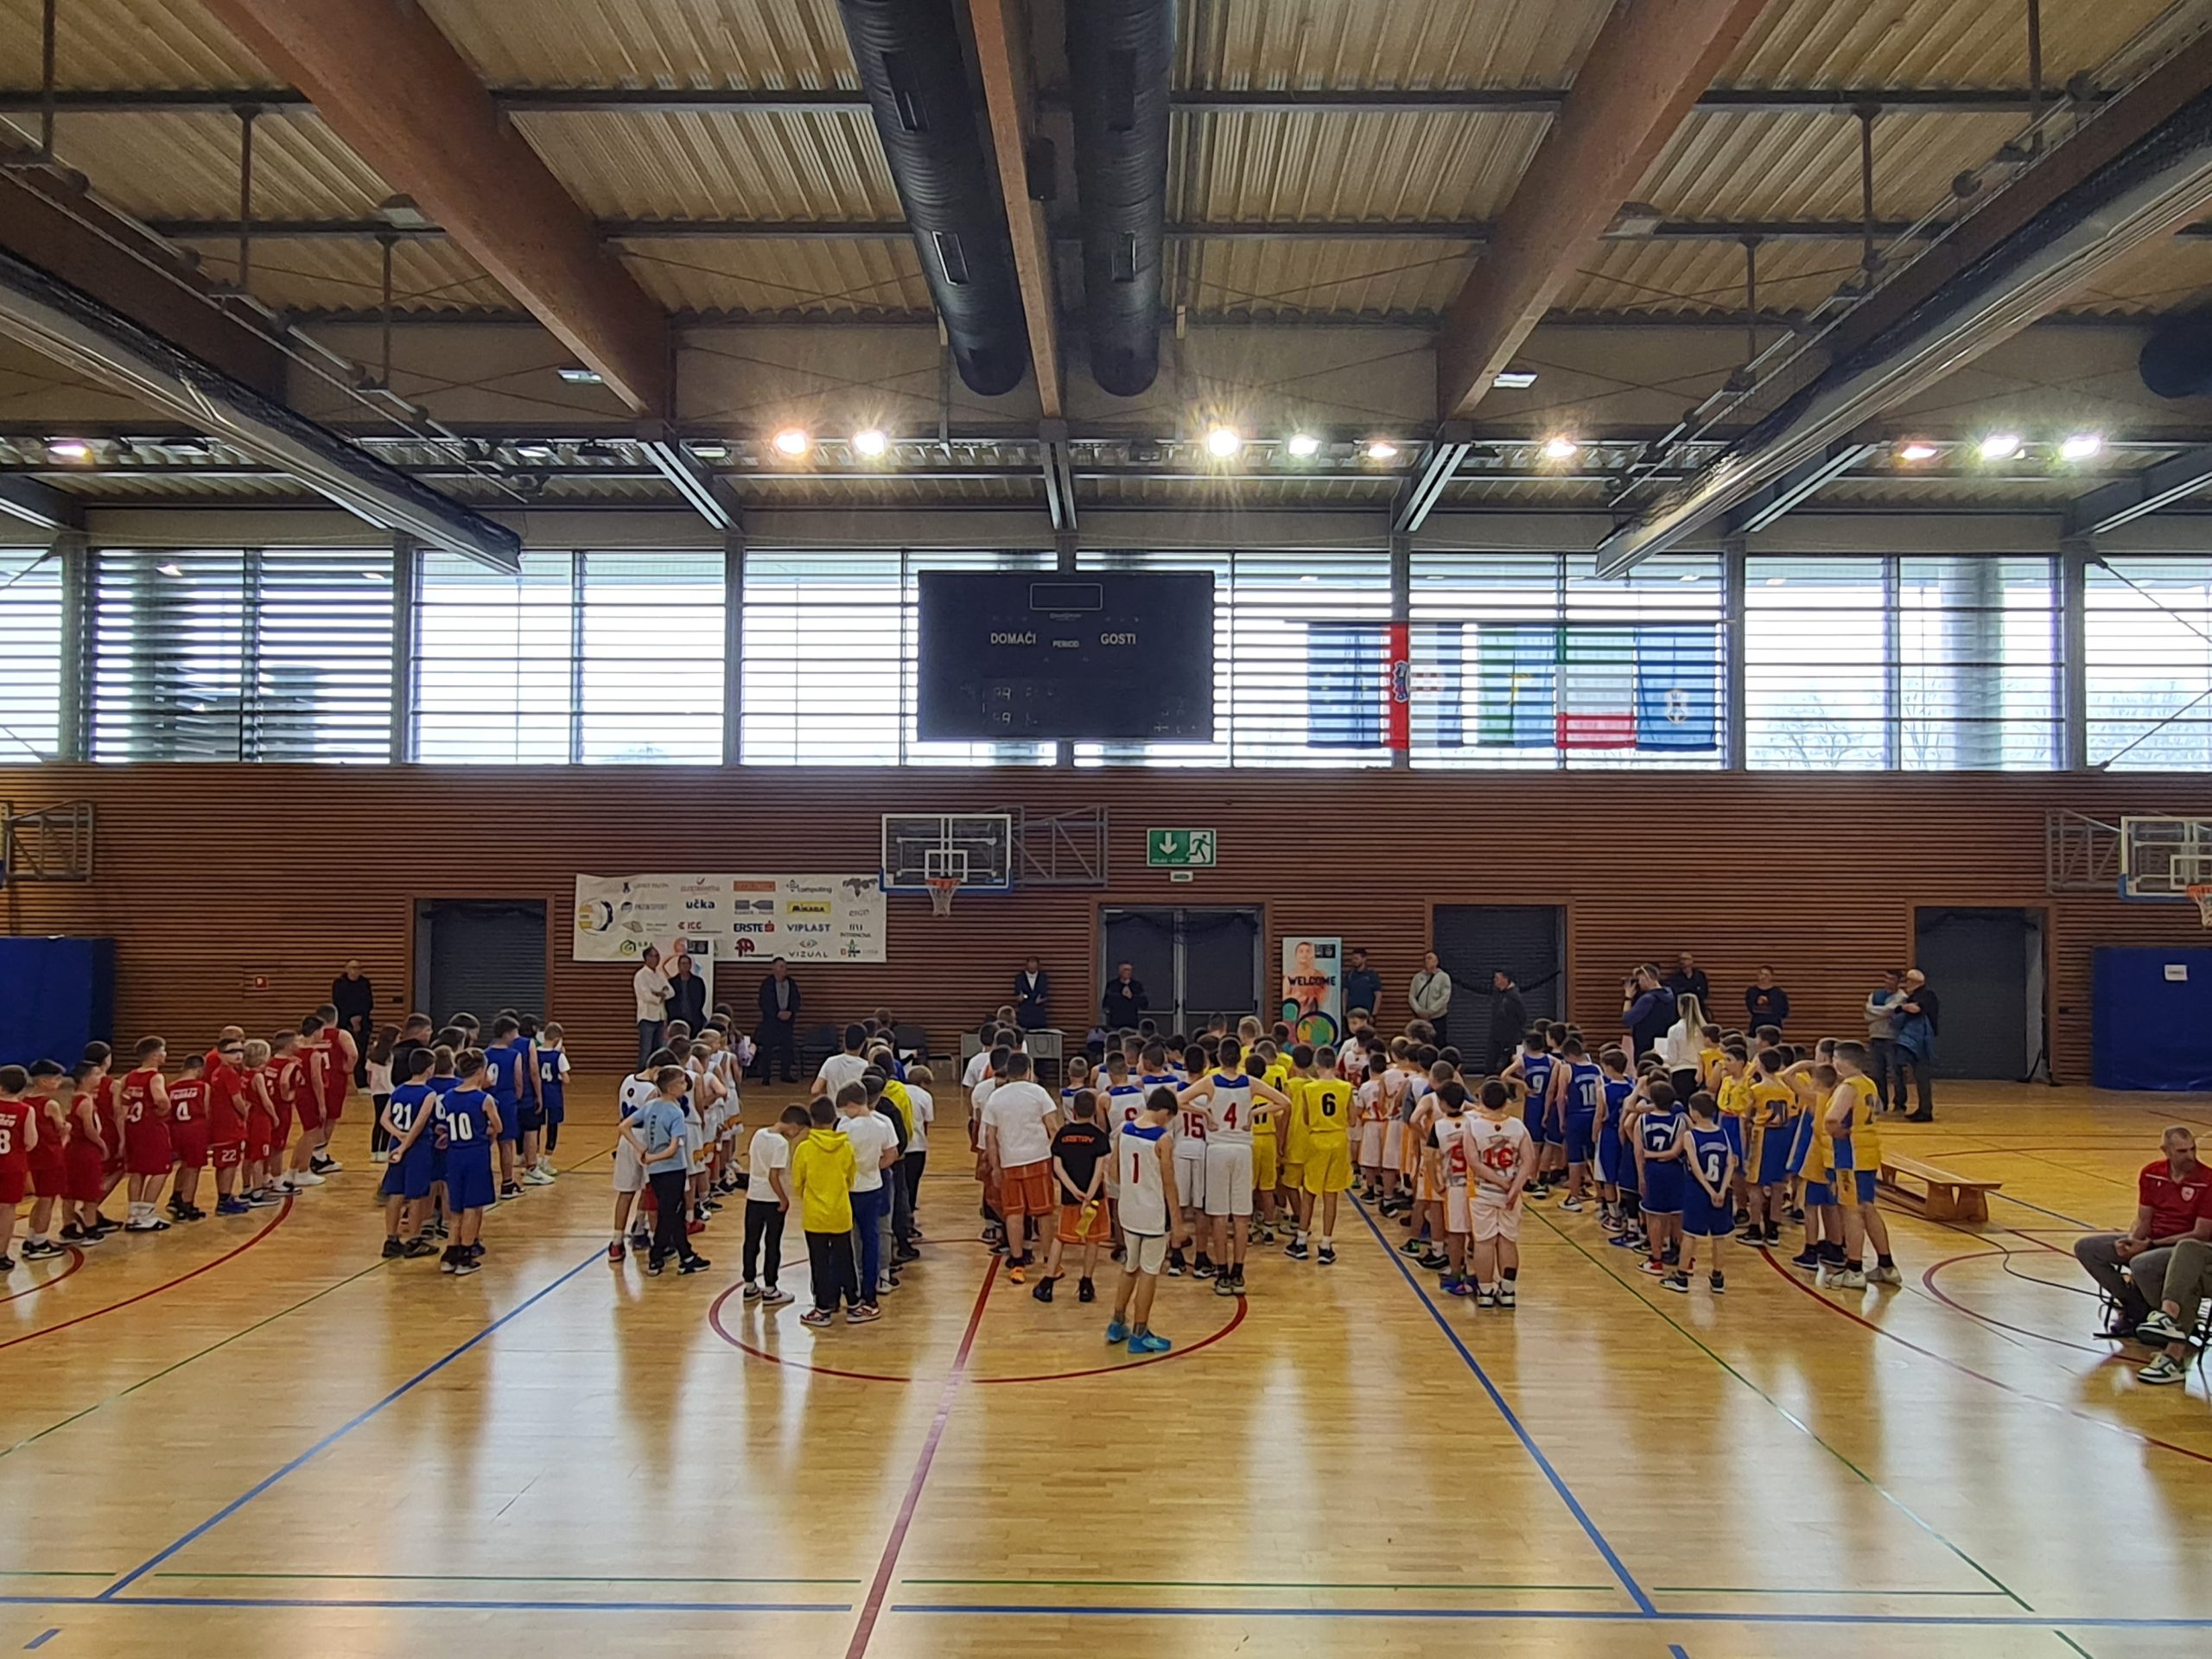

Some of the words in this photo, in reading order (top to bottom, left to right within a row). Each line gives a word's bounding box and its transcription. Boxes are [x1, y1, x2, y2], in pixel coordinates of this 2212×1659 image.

[990, 631, 1036, 645] DOMAĆI
[1100, 633, 1136, 645] GOSTI
[686, 899, 715, 909] učka
[734, 923, 763, 932] ERSTE
[787, 924, 831, 932] VIPLAST
[1288, 976, 1337, 987] WELCOME
[541, 1062, 553, 1082] 4
[1532, 1074, 1544, 1094] 9
[1321, 1092, 1337, 1117] 6
[391, 1102, 412, 1130] 21
[1183, 1112, 1205, 1139] 15
[1224, 1102, 1237, 1130] 4
[447, 1112, 473, 1141] 10
[221, 1148, 238, 1162] 22
[1132, 1152, 1140, 1185] 1
[1706, 1153, 1719, 1183] 6
